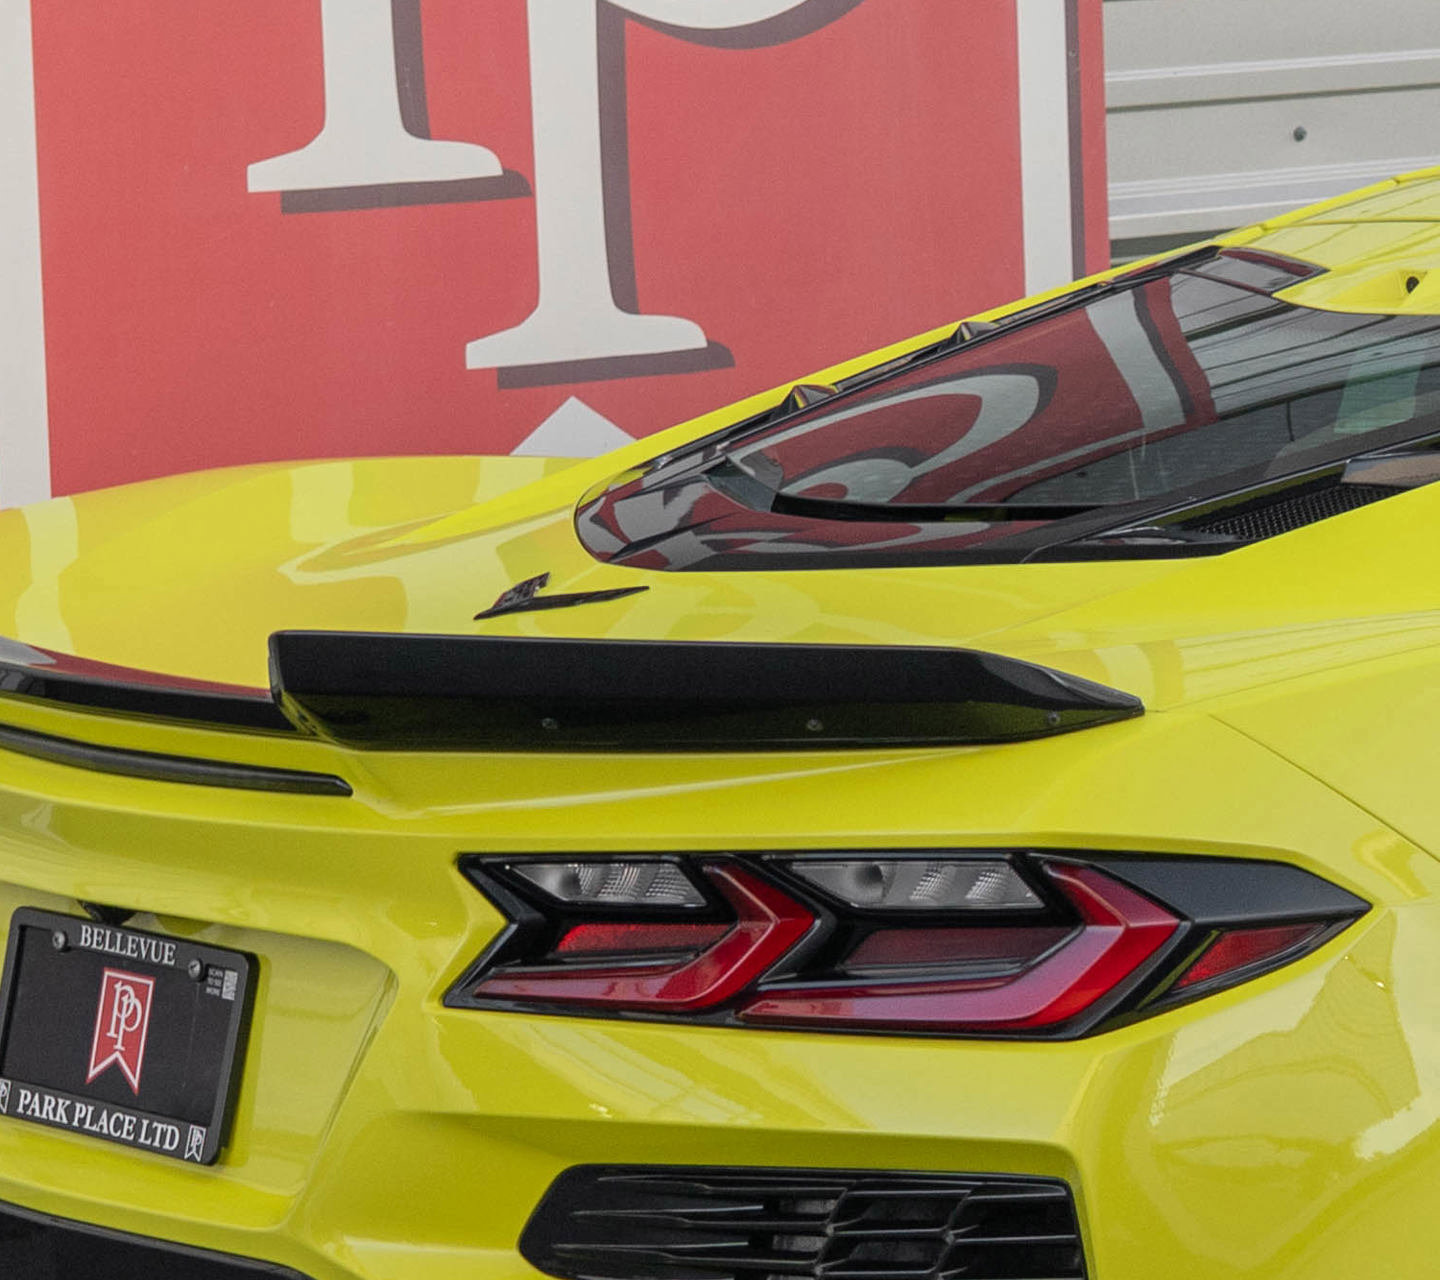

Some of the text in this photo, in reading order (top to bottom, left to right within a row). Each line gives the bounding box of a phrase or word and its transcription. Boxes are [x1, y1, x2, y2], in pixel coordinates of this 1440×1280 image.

[80, 925, 176, 966] BELLEVUE
[16, 1089, 180, 1151] PARK PLACE LTD
